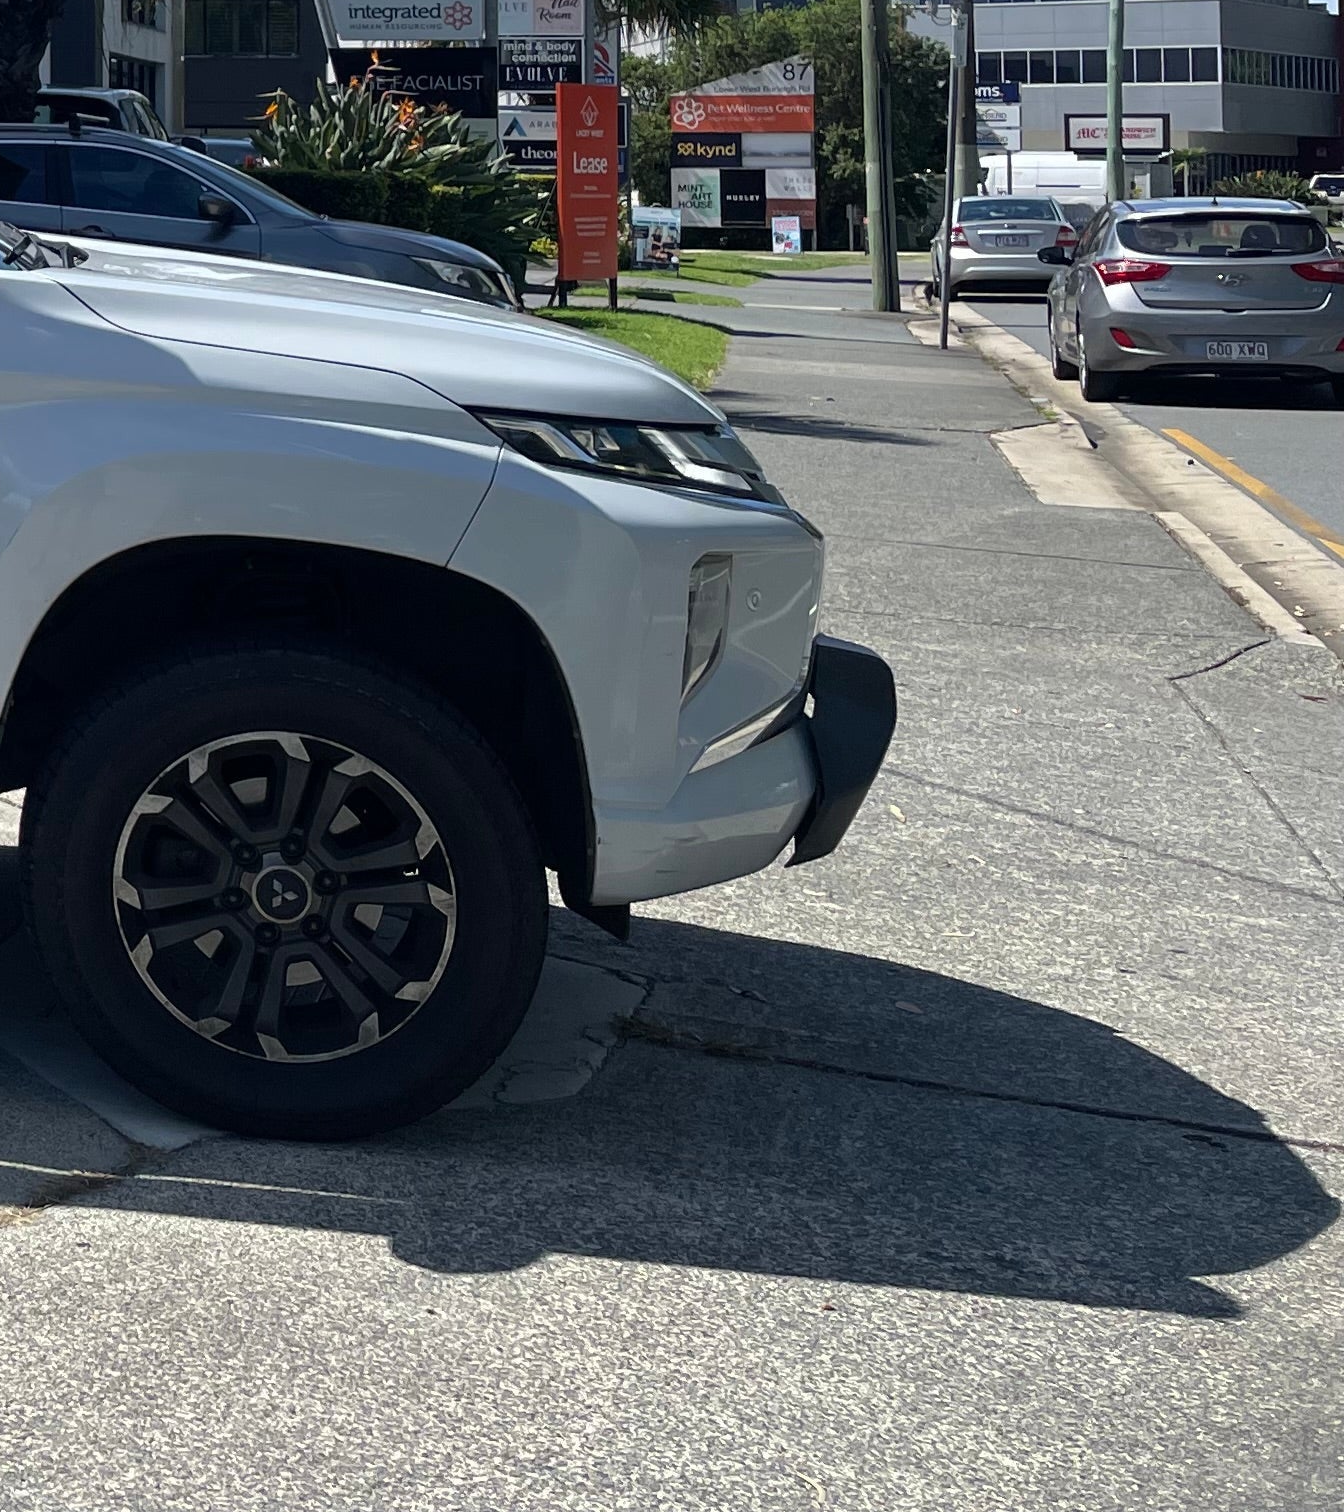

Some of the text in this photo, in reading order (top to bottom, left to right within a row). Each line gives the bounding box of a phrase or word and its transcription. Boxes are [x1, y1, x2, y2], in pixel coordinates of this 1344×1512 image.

[348, 3, 442, 23] integrated
[504, 41, 576, 53] mind & body
[512, 53, 576, 63] connection
[506, 67, 568, 82] EVOLVE
[783, 63, 810, 80] 87
[393, 75, 484, 90] FACIALIST
[707, 104, 811, 113] Pet Wellness Centre
[697, 142, 736, 158] kynd
[573, 151, 608, 174] Lease
[678, 184, 703, 192] MINT
[691, 192, 712, 200] ART
[678, 201, 712, 209] HOUSE
